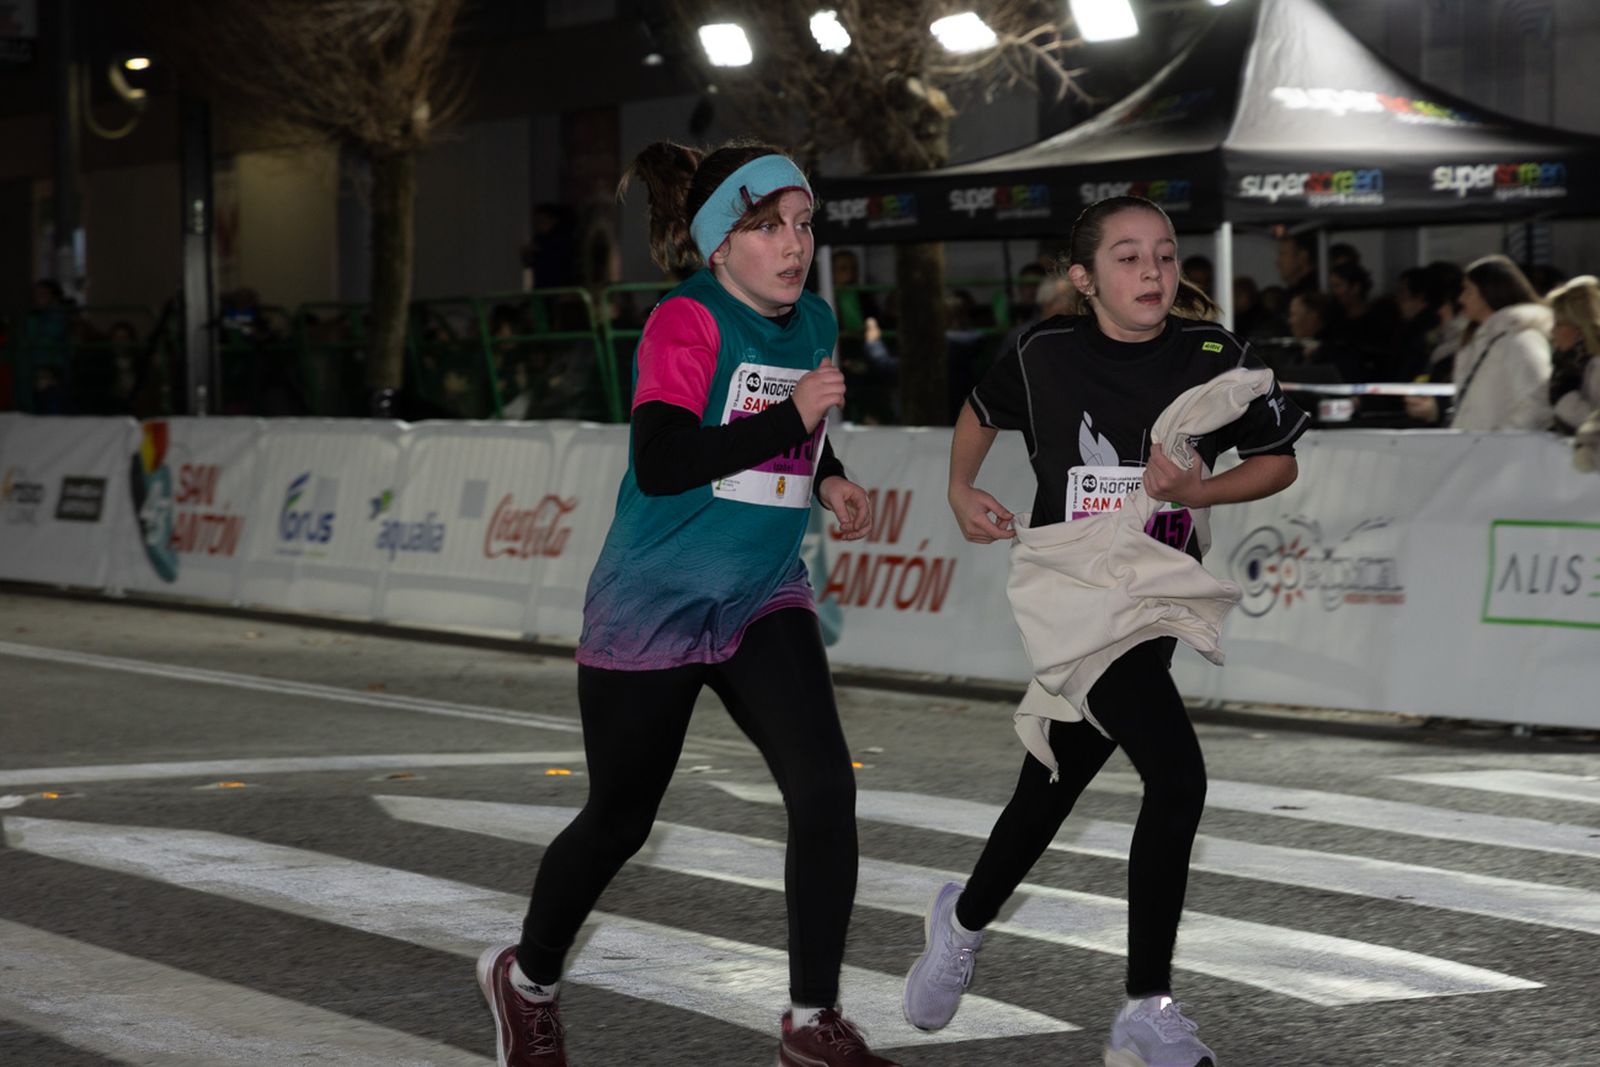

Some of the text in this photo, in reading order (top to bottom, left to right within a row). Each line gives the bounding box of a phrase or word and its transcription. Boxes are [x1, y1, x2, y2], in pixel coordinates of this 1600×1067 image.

[1240, 170, 1384, 203] superscreen
[1432, 163, 1567, 198] superscreen
[747, 377, 760, 388] 43
[175, 464, 225, 505] SAN
[1083, 478, 1096, 488] 43
[1099, 482, 1141, 494] NOCHE
[1082, 497, 1110, 511] SAN
[375, 512, 446, 562] aqualia
[818, 539, 957, 613] ANTÓN
